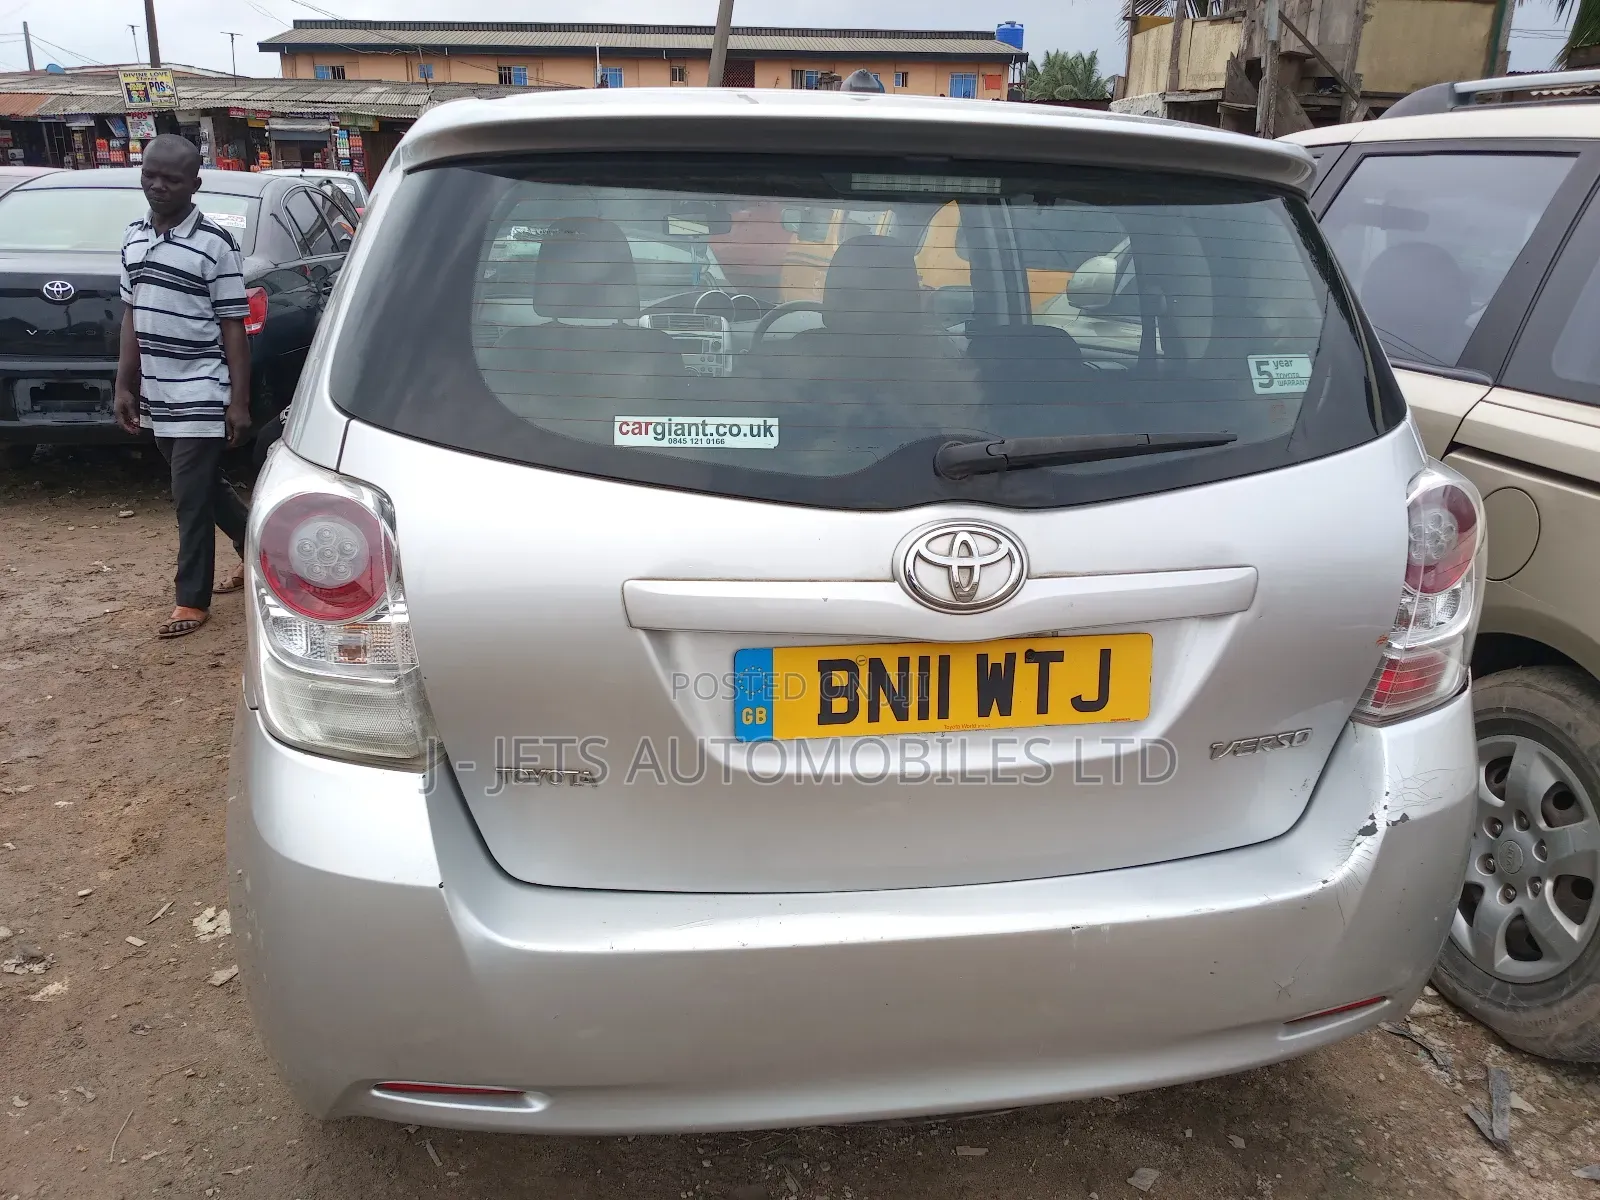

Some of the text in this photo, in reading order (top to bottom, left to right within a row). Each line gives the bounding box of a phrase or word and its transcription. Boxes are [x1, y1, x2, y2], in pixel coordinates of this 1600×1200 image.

[149, 81, 166, 92] POS
[1255, 360, 1293, 388] 5 year
[618, 418, 775, 441] cargiant.co.uk
[668, 437, 688, 445] 0845
[976, 648, 1112, 718] WTJ
[741, 706, 767, 725] GB
[1209, 727, 1313, 761] VERSO
[496, 766, 598, 787] TOYOTA
